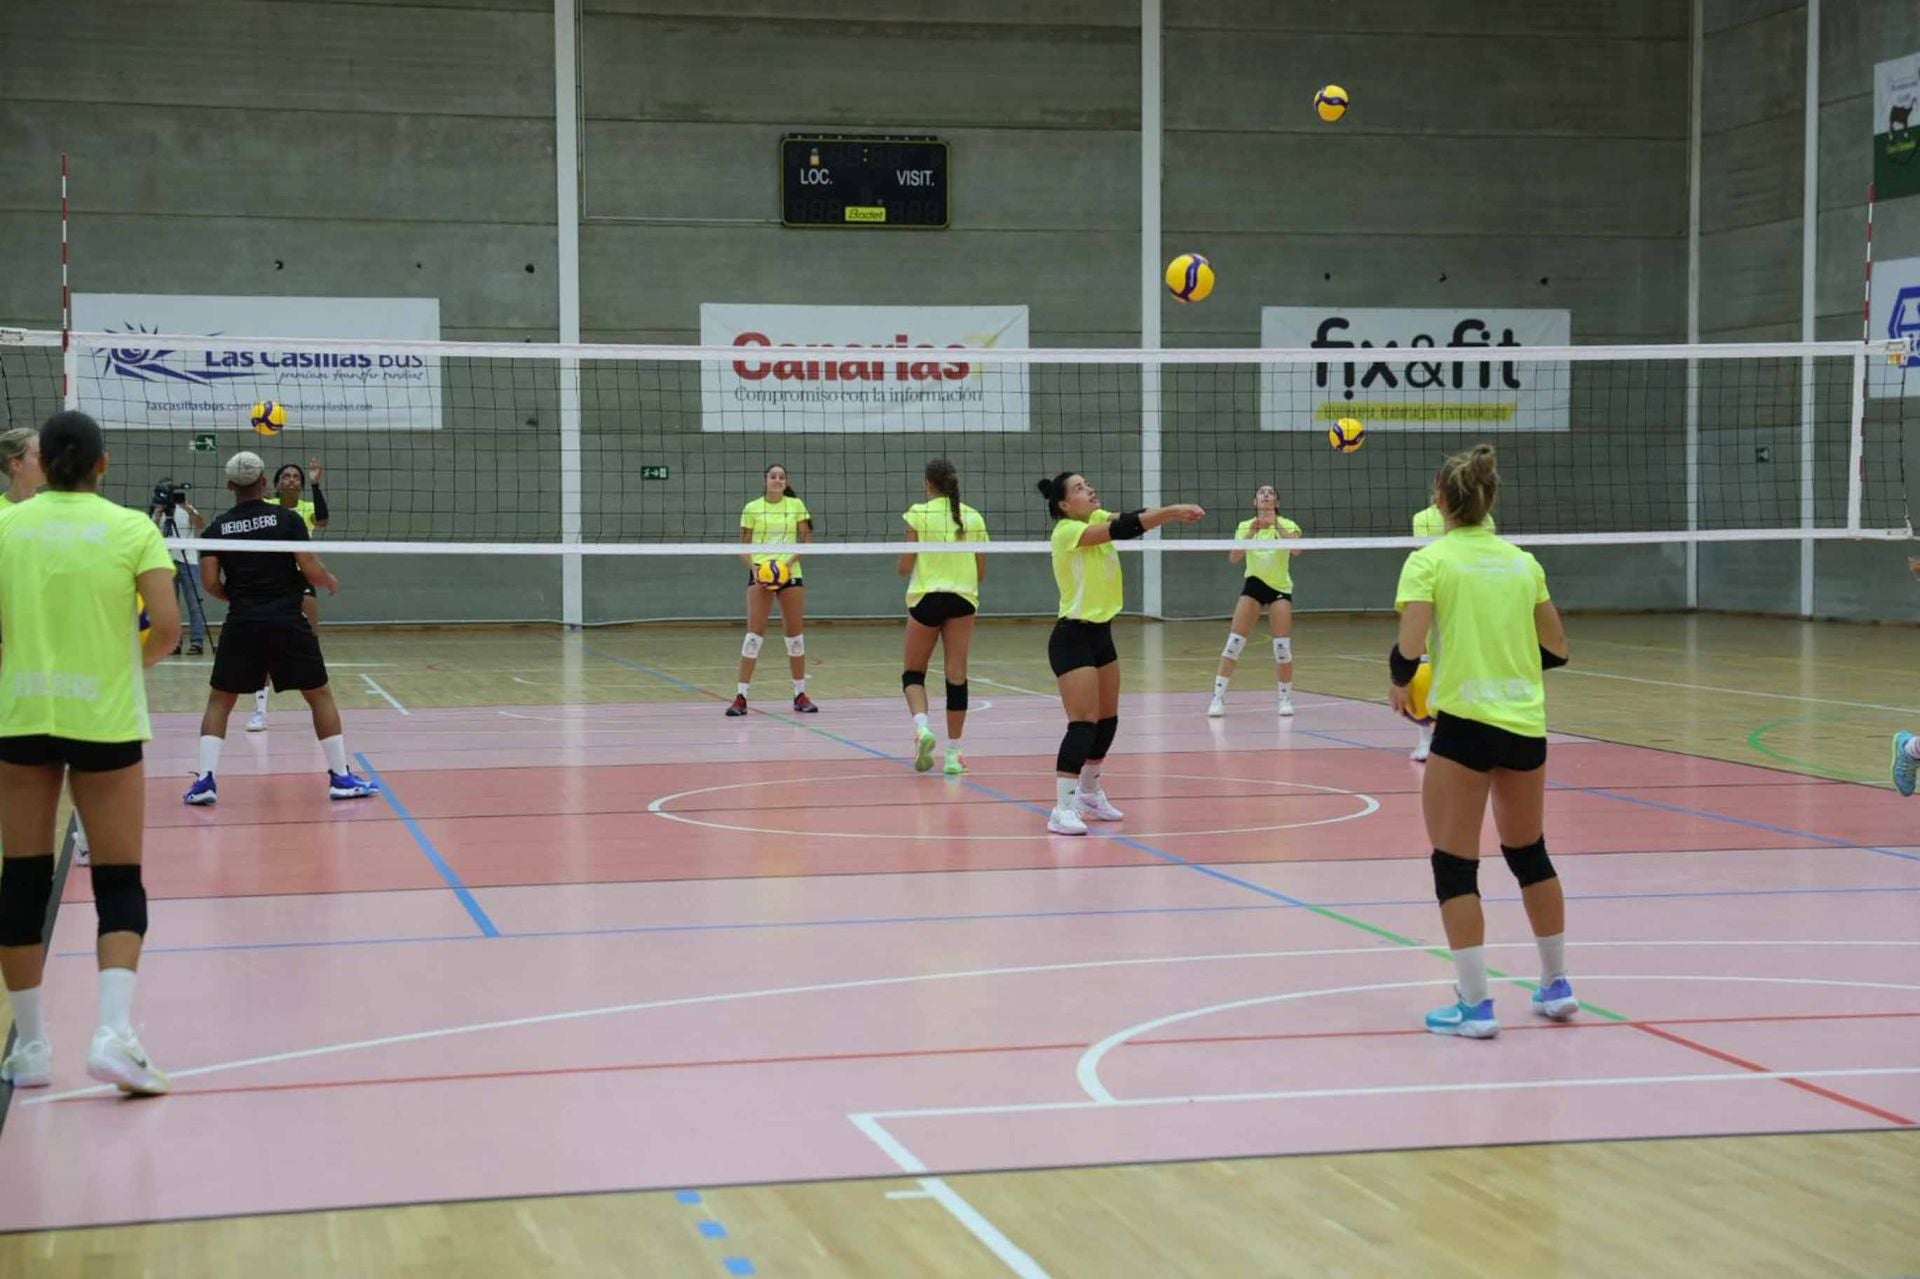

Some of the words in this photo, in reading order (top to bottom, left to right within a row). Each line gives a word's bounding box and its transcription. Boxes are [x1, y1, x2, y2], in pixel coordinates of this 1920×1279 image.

[799, 168, 833, 185] LOC.
[895, 169, 936, 187] VISIT.
[205, 350, 254, 368] Las
[734, 386, 839, 406] Compromiso
[841, 390, 870, 403] con
[873, 387, 886, 403] la
[889, 387, 983, 403] información
[221, 514, 278, 536] HEIDELBERG
